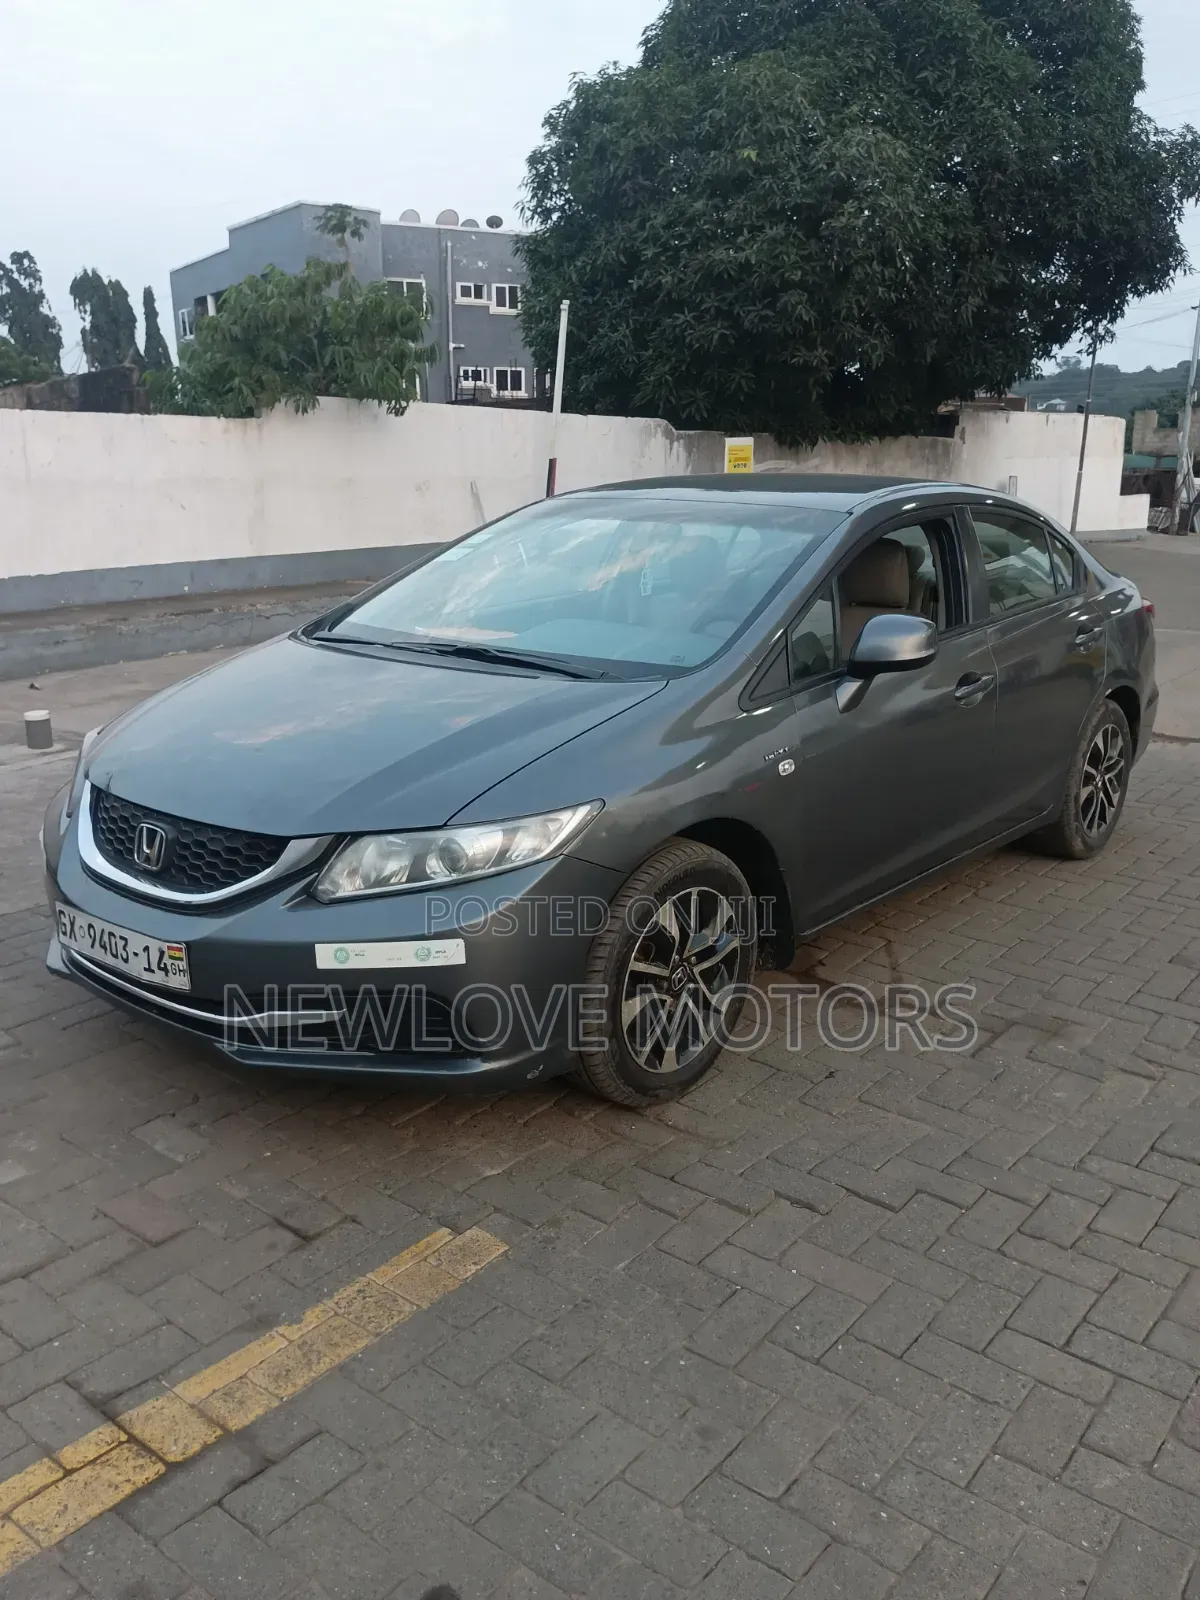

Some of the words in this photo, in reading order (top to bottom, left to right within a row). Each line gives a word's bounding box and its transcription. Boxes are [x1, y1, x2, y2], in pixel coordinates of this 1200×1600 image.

[58, 909, 78, 942] GX
[87, 923, 170, 977] 9403-14
[170, 962, 187, 978] GH
